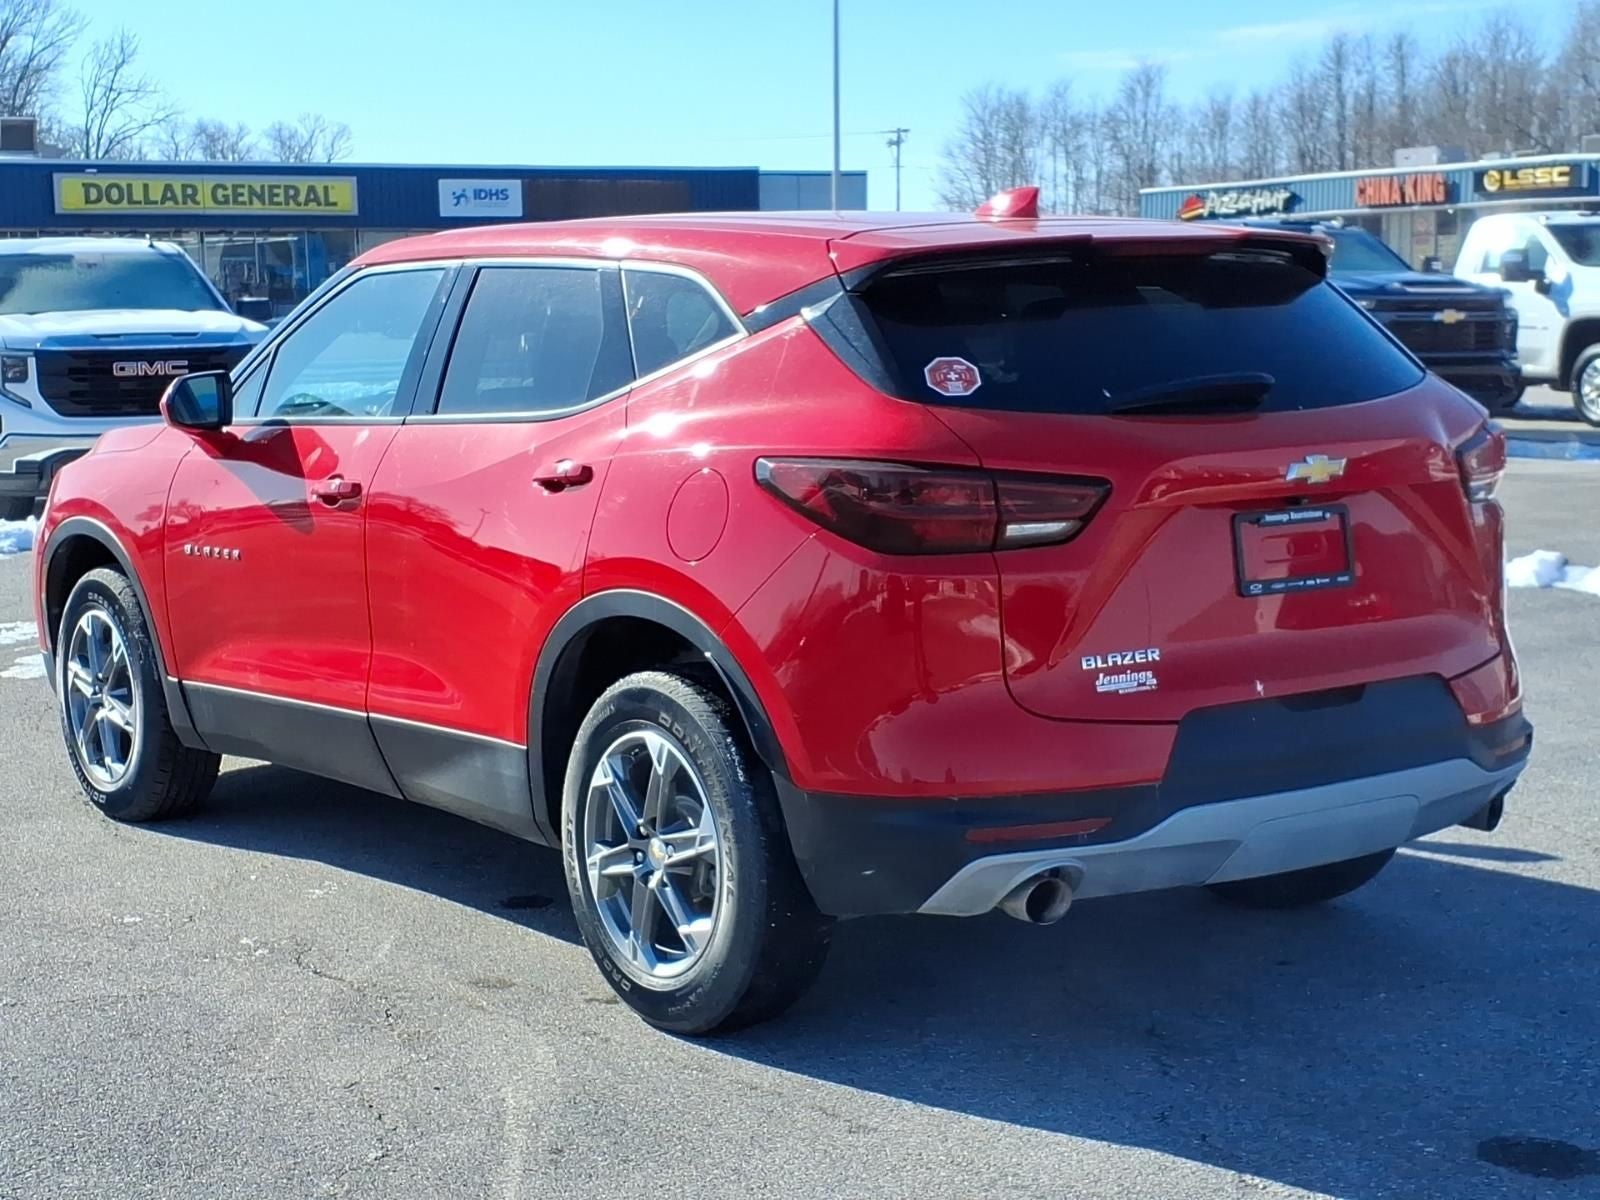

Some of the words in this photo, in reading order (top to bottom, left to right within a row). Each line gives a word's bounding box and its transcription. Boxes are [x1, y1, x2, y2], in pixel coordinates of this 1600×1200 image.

[1503, 166, 1571, 186] LSSC
[81, 182, 200, 205] DOLLAR
[210, 183, 338, 207] GENERAL
[473, 188, 510, 201] IDHS
[1356, 176, 1402, 206] CHINA
[1404, 173, 1445, 204] KING
[113, 360, 189, 376] GMC
[183, 543, 241, 561] BLAZER
[1081, 647, 1160, 670] BLAZER
[1095, 670, 1153, 686] Jennings
